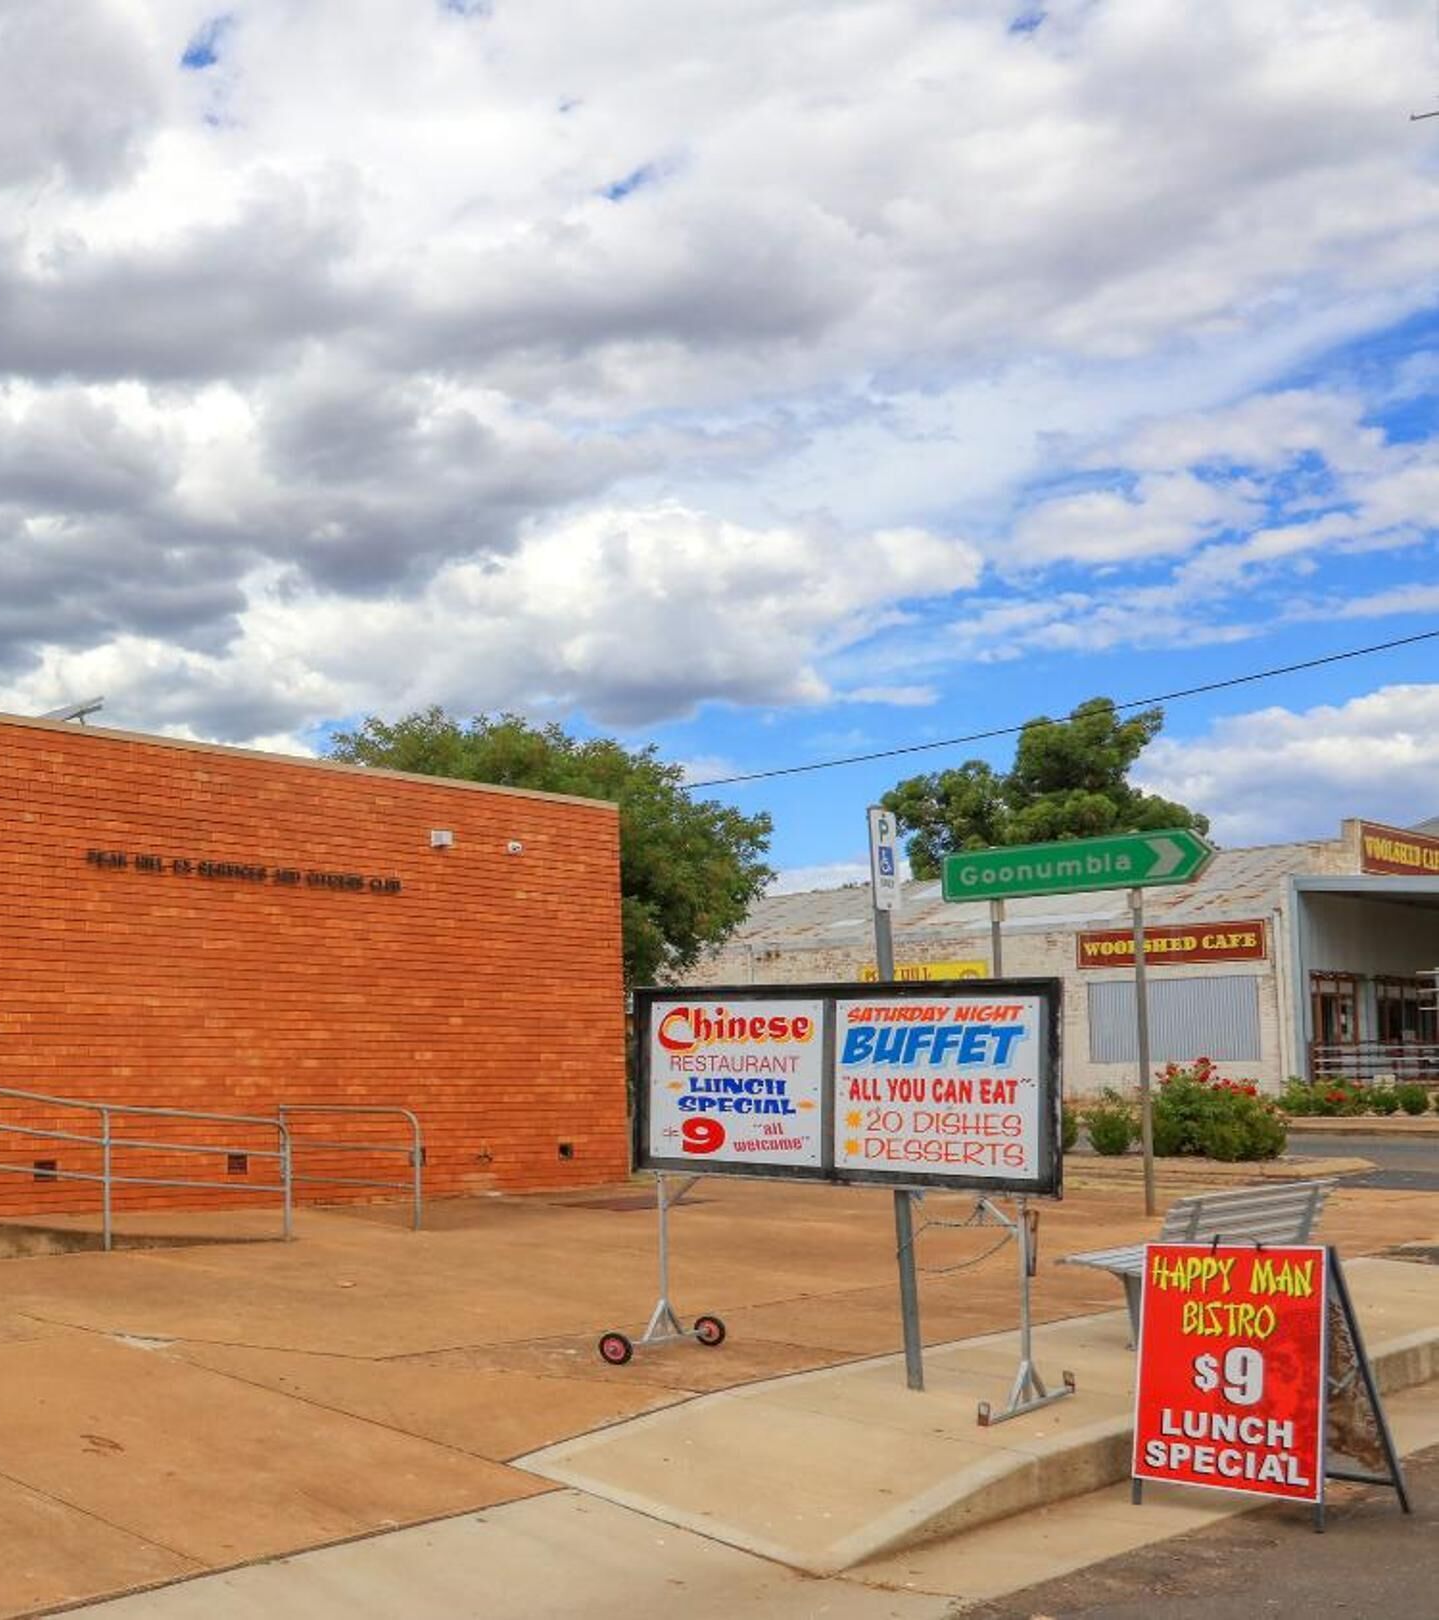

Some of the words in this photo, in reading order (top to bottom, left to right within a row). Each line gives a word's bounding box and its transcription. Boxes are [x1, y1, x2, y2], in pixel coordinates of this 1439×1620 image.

[878, 819, 889, 842] P
[961, 853, 1132, 886] Goonumbla
[1202, 932, 1257, 950] CAFE
[847, 1006, 950, 1024] SATURDAY
[954, 1005, 1024, 1023] NIGHT
[657, 1006, 814, 1053] Chinese
[841, 1025, 1027, 1067] BUFFET
[670, 1055, 800, 1073] RESTAURANT
[689, 1076, 787, 1095] LUNCH
[887, 1078, 926, 1102] YOU
[932, 1078, 973, 1104] CAN
[677, 1096, 797, 1115] SPECIAL
[866, 1109, 903, 1132] 20
[913, 1112, 1022, 1136] DISHES
[864, 1138, 1025, 1167] DESSERTS
[1152, 1255, 1237, 1293] HAPPY
[1249, 1259, 1314, 1297] MAN
[1182, 1301, 1277, 1339] BISTRO
[1193, 1347, 1264, 1406] $9
[1161, 1408, 1294, 1449] LUNCH
[1144, 1440, 1310, 1487] SPECIAL
